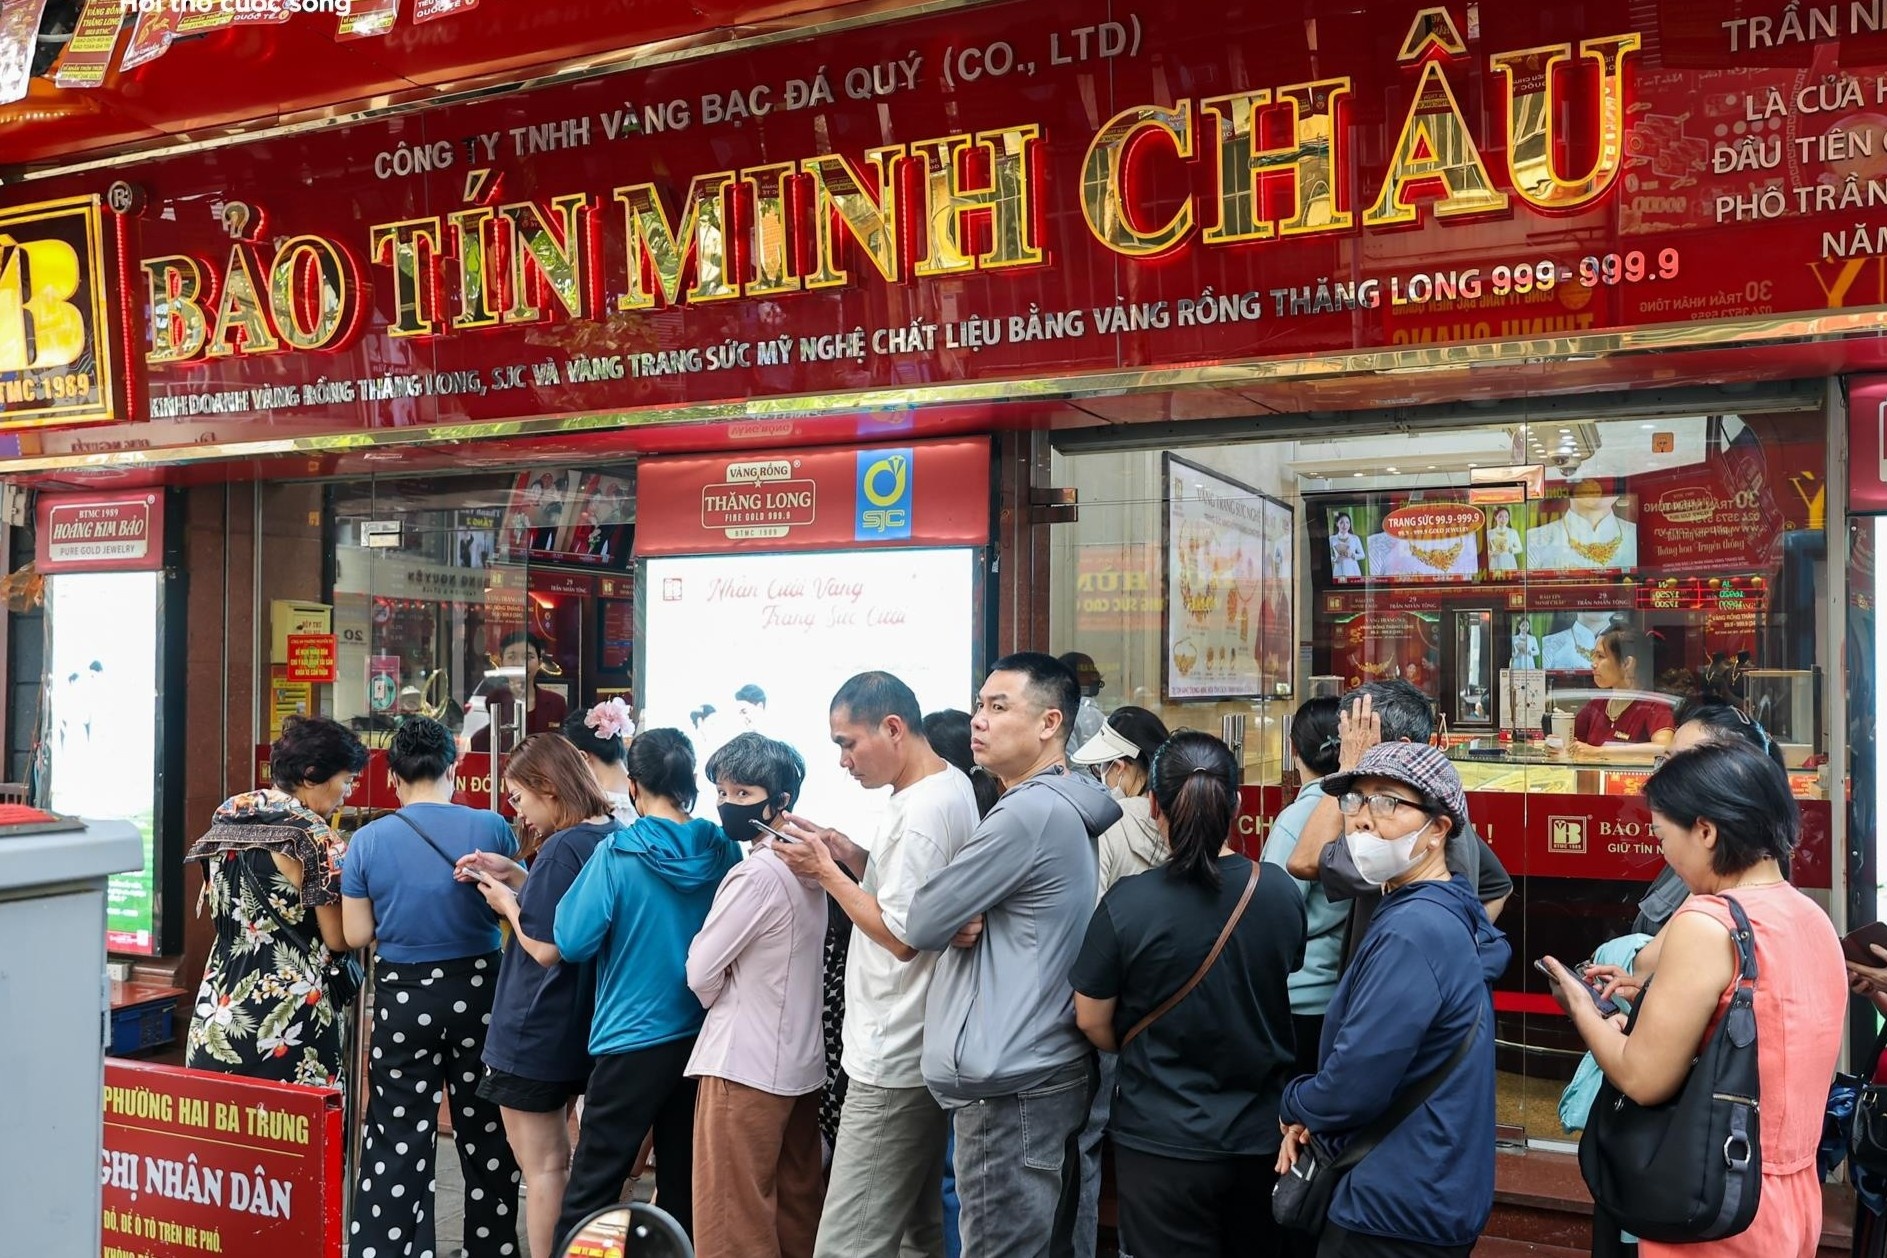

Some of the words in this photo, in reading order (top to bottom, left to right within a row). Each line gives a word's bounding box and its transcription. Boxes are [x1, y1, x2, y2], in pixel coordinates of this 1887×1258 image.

[1722, 0, 1837, 52] TRẦN
[374, 141, 453, 179] CÔNG
[462, 132, 499, 165] TY
[509, 117, 591, 157] TNHH
[600, 101, 690, 141] VÀNG
[702, 85, 772, 128] BẠC
[784, 66, 834, 111] ĐÁ
[845, 50, 924, 101] QUÝ
[1050, 13, 1142, 66] LTD)
[1746, 87, 1788, 122] LÀ
[1796, 74, 1865, 115] CỬA
[1712, 134, 1782, 175] ĐẦU
[1795, 127, 1873, 164] TIÊN
[140, 200, 347, 364] BẢO
[370, 168, 586, 338] TÍN
[614, 123, 1044, 311] MINH
[1079, 5, 1642, 256] CHÂU
[1793, 172, 1887, 214] TRẦN
[252, 383, 300, 411] VÀNG
[357, 371, 422, 401] THĂNG
[491, 365, 527, 391] SJC
[532, 357, 561, 387] VÀ
[566, 353, 625, 384] VÀNG
[627, 347, 703, 378] TRANG
[705, 338, 751, 372] SỨC
[756, 333, 793, 367] MỸ
[799, 326, 866, 364] NGHỆ
[872, 315, 938, 356] CHẤT
[945, 313, 1001, 353] LIỆU
[1008, 302, 1085, 344] BẰNG
[1092, 295, 1171, 335] VÀNG
[1177, 285, 1263, 327] RỒNG
[1270, 277, 1380, 318] THĂNG
[1391, 269, 1483, 306] LONG
[41, 373, 90, 400] 1989
[729, 465, 758, 478] VÀNG
[79, 509, 101, 519] BTMC
[101, 508, 119, 518] 1989
[704, 491, 762, 512] THĂNG
[766, 491, 811, 509] LONG
[94, 520, 116, 538] KIM
[1388, 516, 1417, 528] TRANG
[1417, 514, 1435, 526] SỨC
[60, 546, 79, 556] PURE
[80, 545, 101, 555] GOLD
[102, 544, 135, 555] JEWELRY
[1598, 592, 1607, 600] 29
[1599, 817, 1640, 836] BẢO
[1607, 841, 1631, 853] GIỮ
[1635, 842, 1653, 854] TÍN
[103, 1086, 173, 1123] PHƯỜNG
[178, 1097, 209, 1128] HAI
[215, 1100, 240, 1134] BÀ
[246, 1107, 310, 1145] TRƯNG
[145, 1153, 224, 1208] NHÂN
[230, 1164, 293, 1221] DÂN
[158, 1220, 183, 1246] TRÊN
[184, 1225, 198, 1248] HÈ
